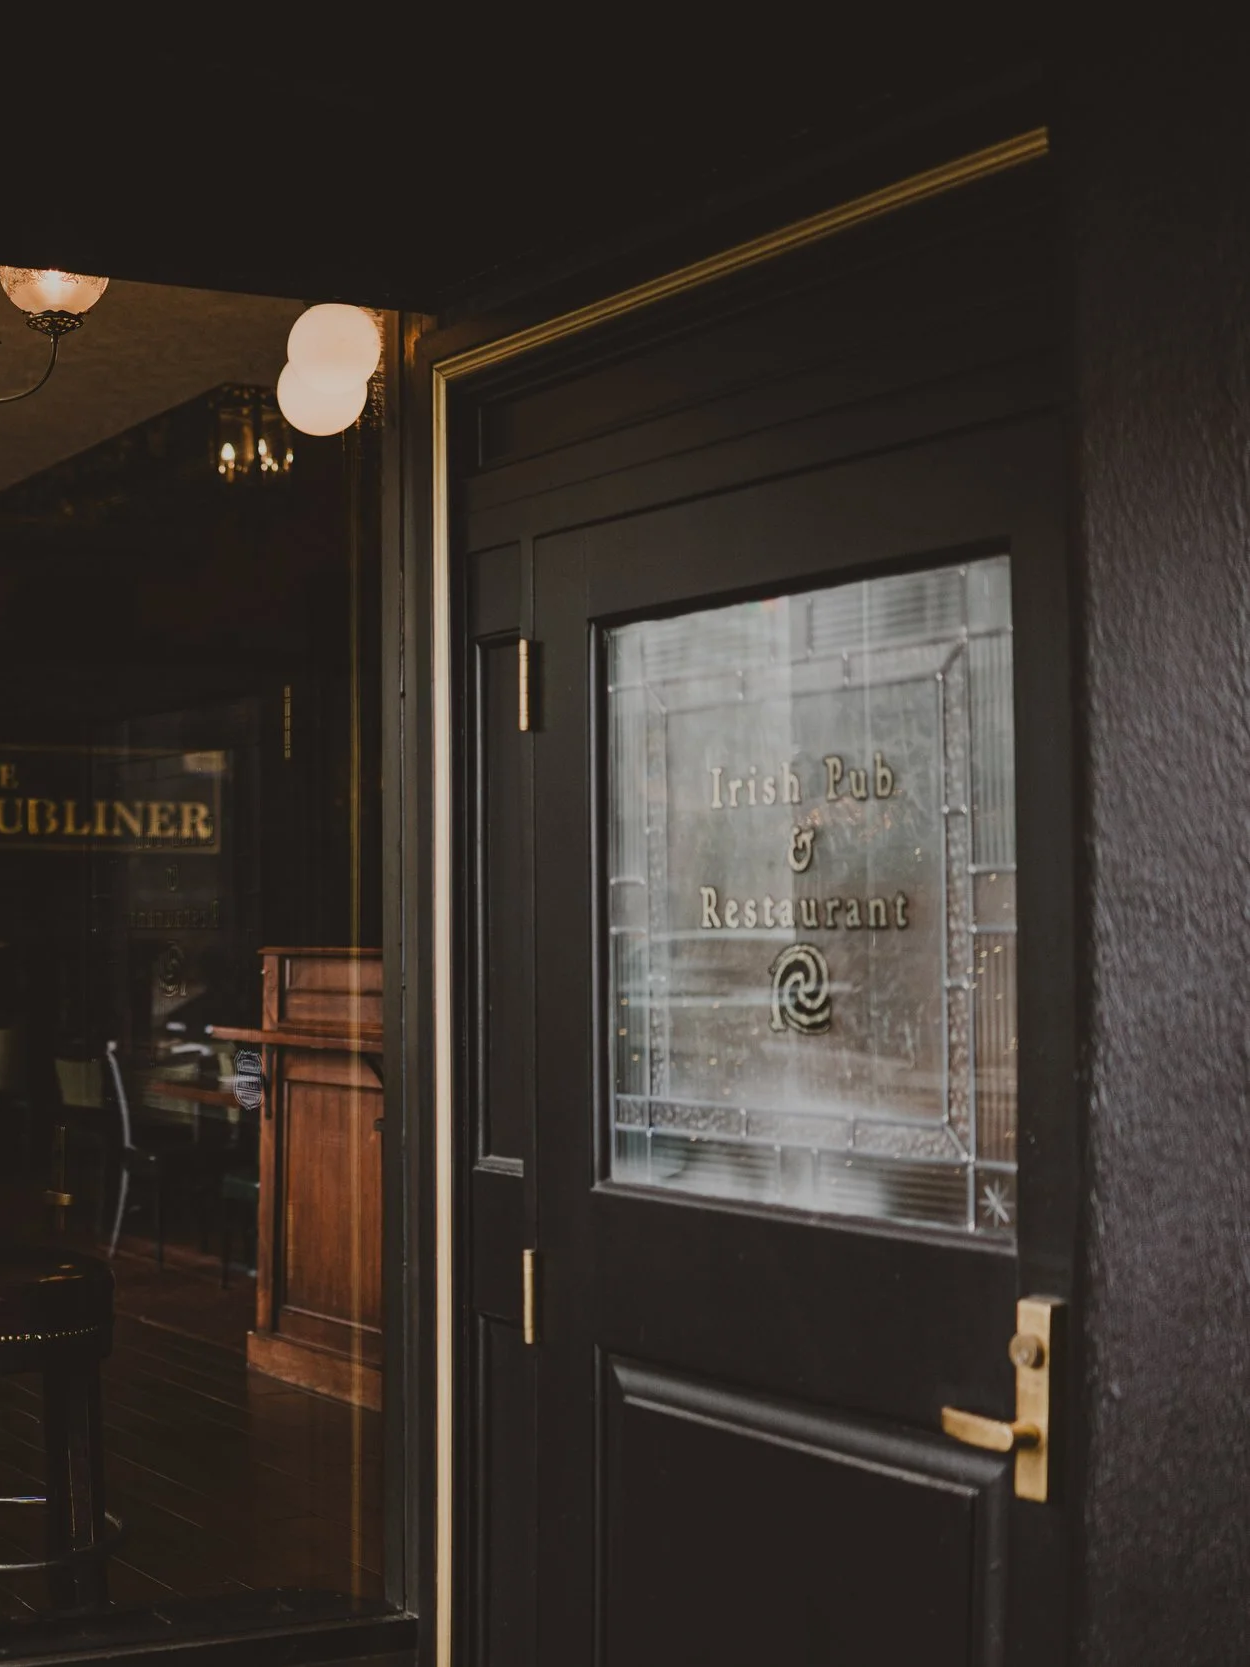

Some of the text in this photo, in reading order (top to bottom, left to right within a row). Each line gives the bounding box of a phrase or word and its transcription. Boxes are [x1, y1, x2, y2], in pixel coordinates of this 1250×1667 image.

[710, 752, 896, 809] Irish Pub
[787, 825, 815, 873] &
[699, 886, 909, 930] Restaurant
